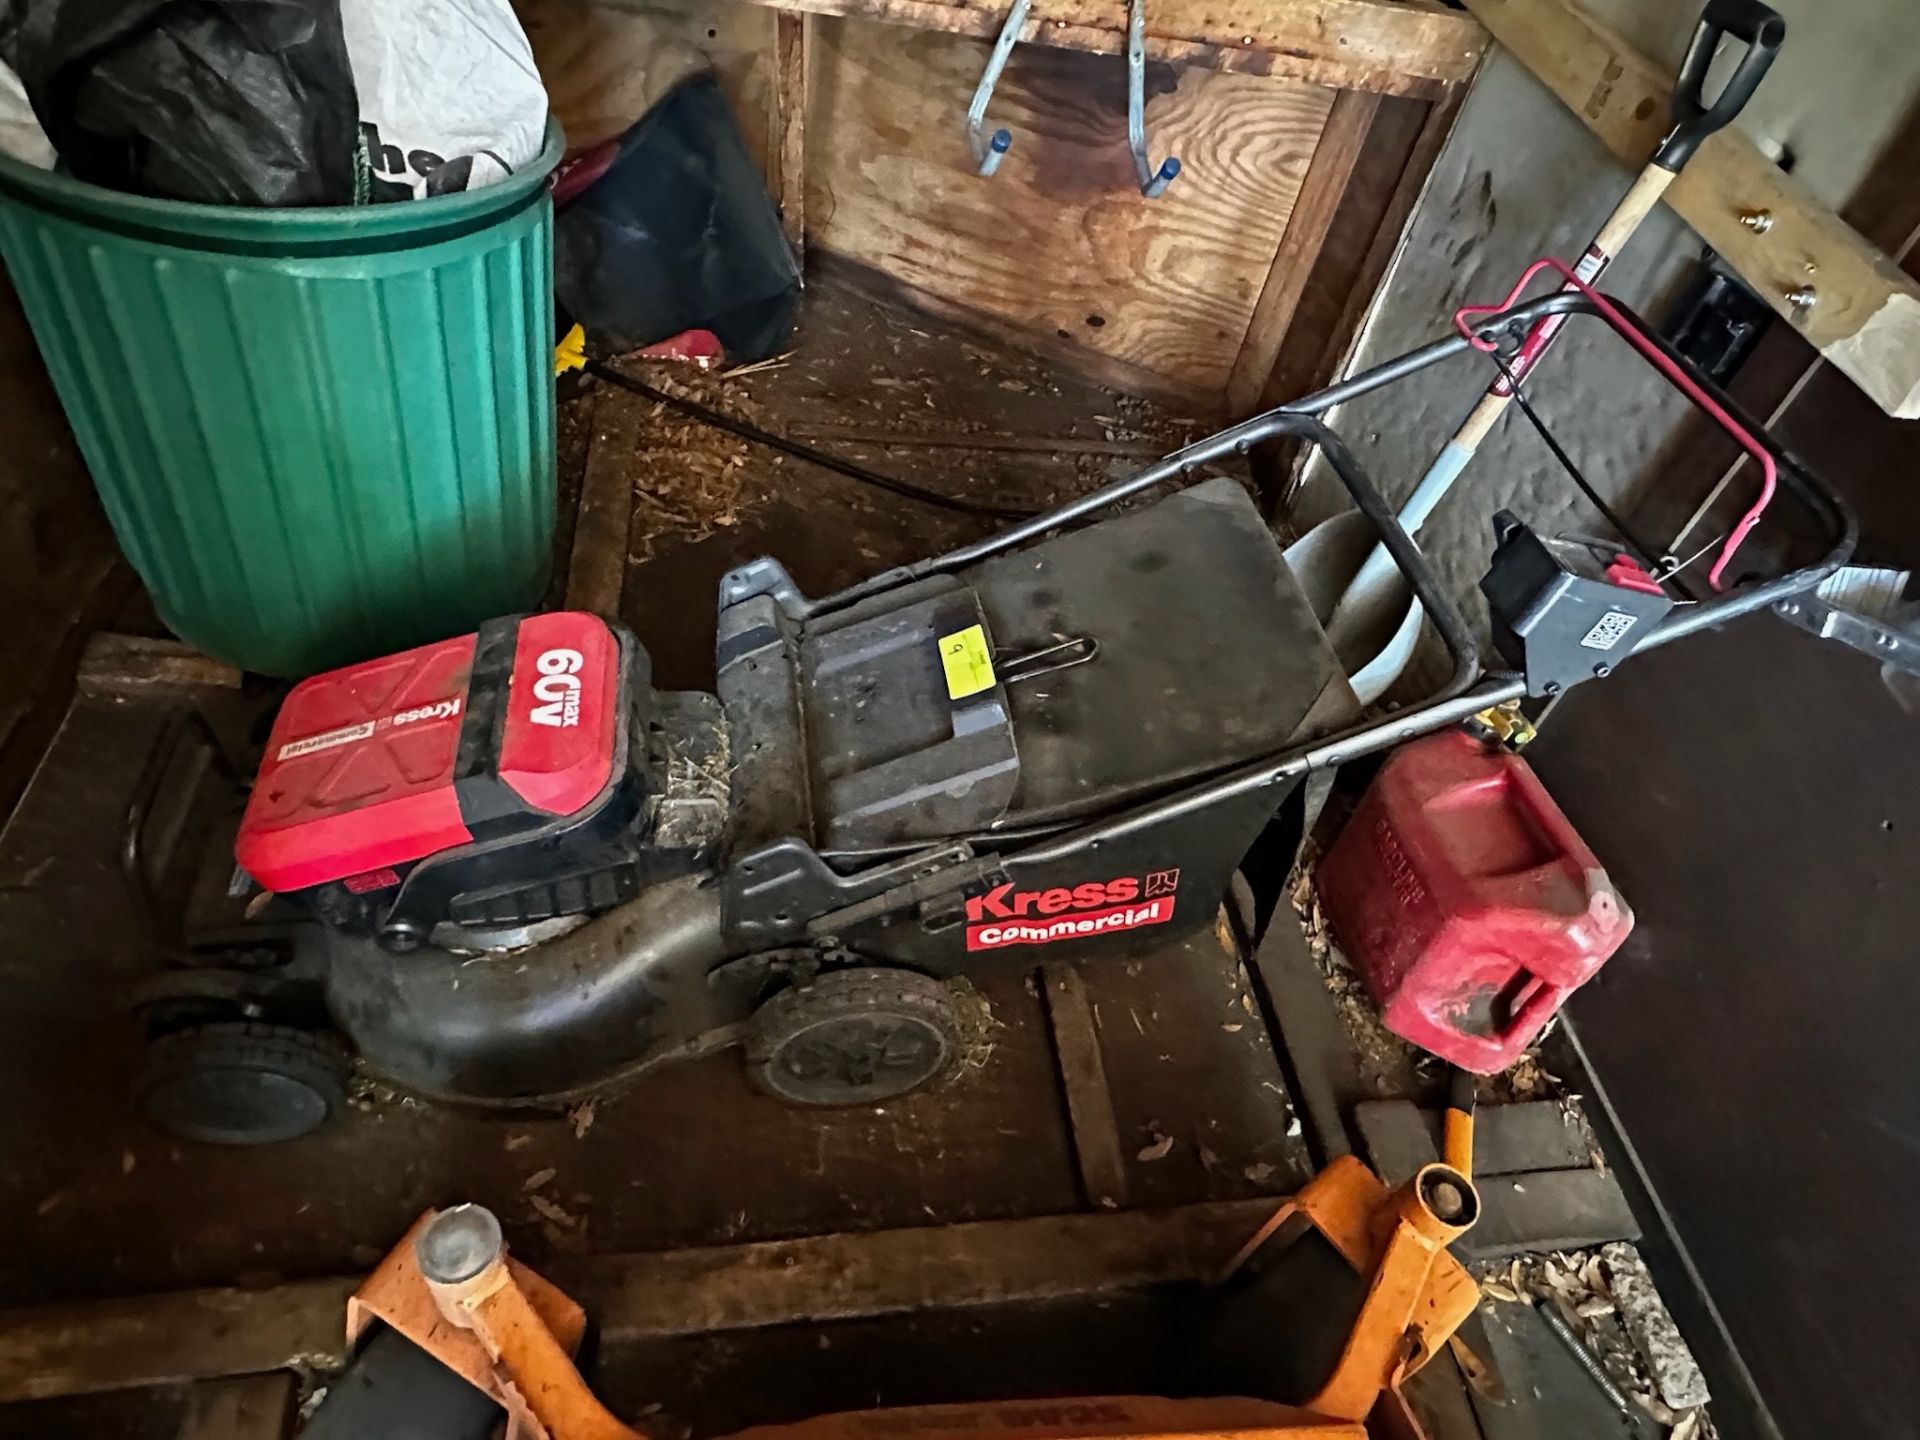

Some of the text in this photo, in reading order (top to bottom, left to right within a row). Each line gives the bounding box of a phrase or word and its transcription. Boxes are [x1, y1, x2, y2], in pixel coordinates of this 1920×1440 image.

[530, 648, 584, 728] 60V
[393, 698, 462, 726] Kress
[965, 877, 1140, 922] Kress
[978, 902, 1161, 945] Commercial
